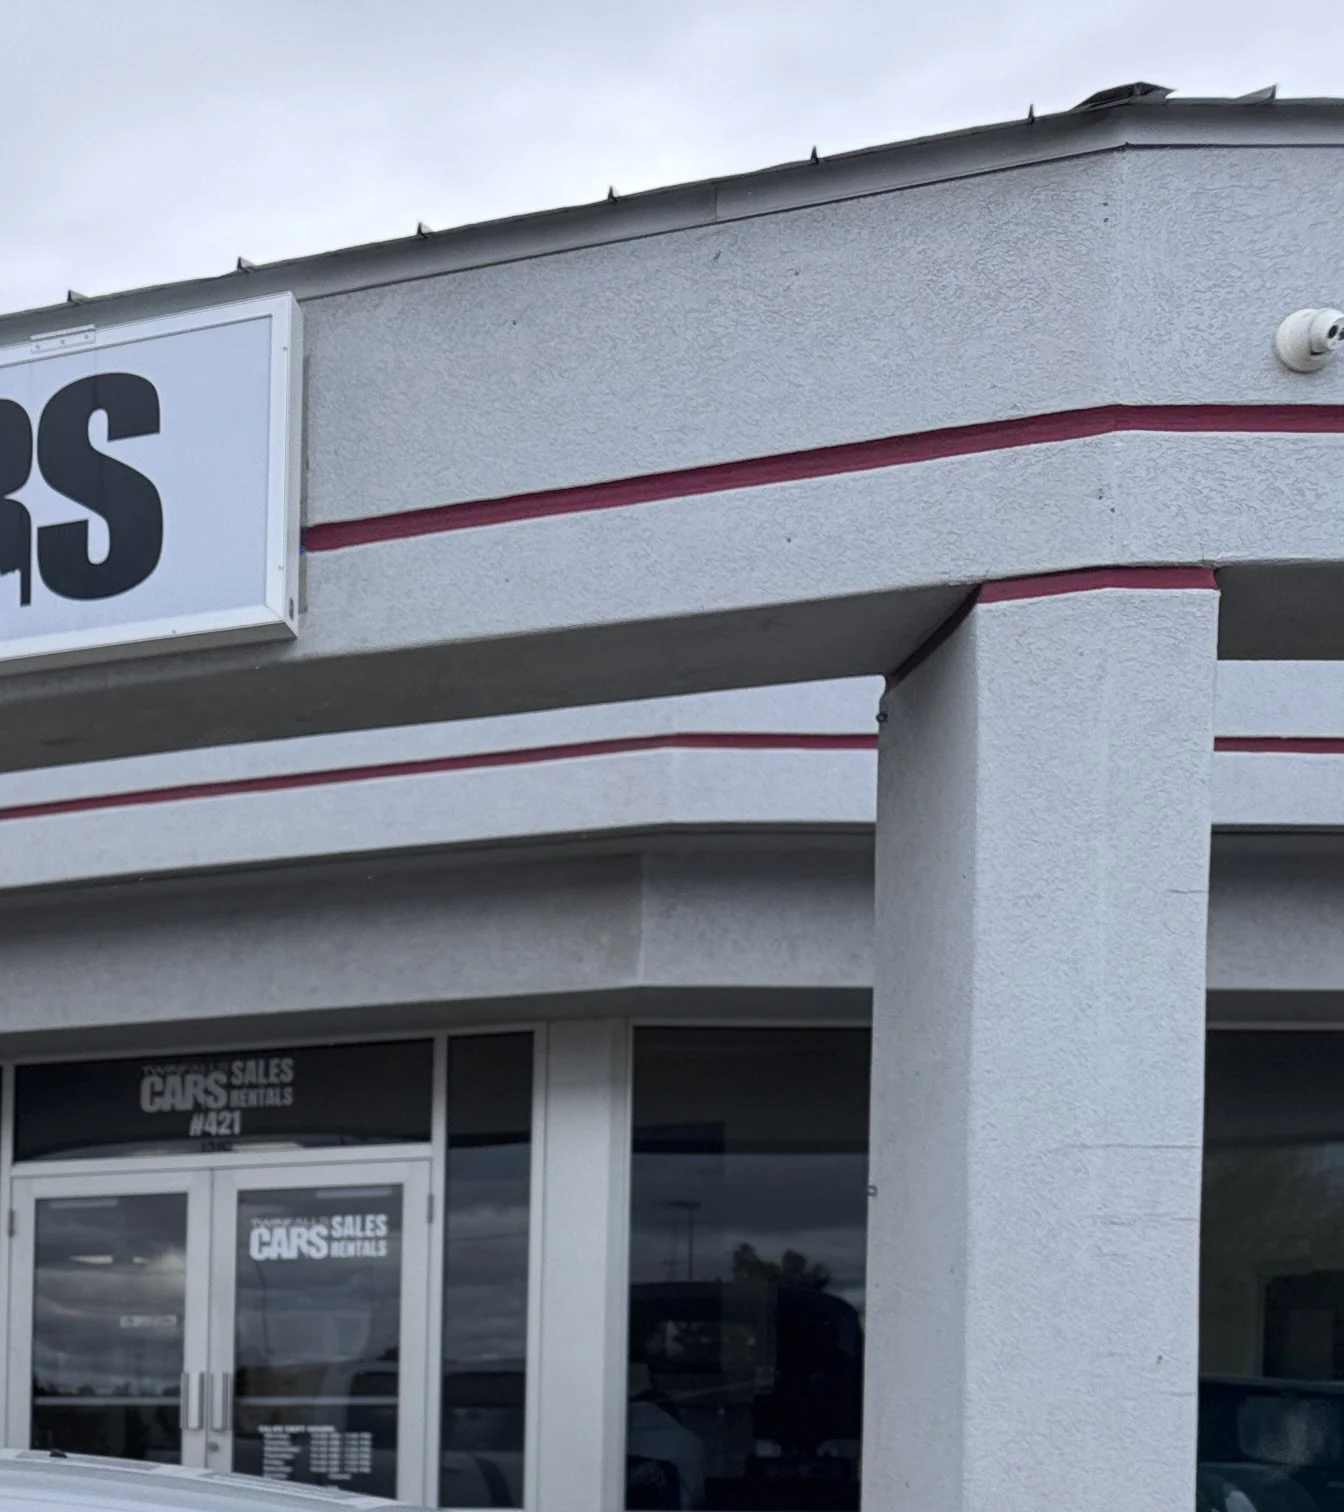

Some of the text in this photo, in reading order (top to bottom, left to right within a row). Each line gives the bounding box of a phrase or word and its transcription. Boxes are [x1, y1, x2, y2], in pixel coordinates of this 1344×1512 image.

[230, 1057, 294, 1085] SALES
[140, 1071, 228, 1113] CARS
[229, 1086, 294, 1108] RENTALS
[189, 1110, 241, 1136] #421
[331, 1214, 388, 1239] SALES
[249, 1224, 329, 1261] CARS
[330, 1239, 388, 1258] RENTALS
